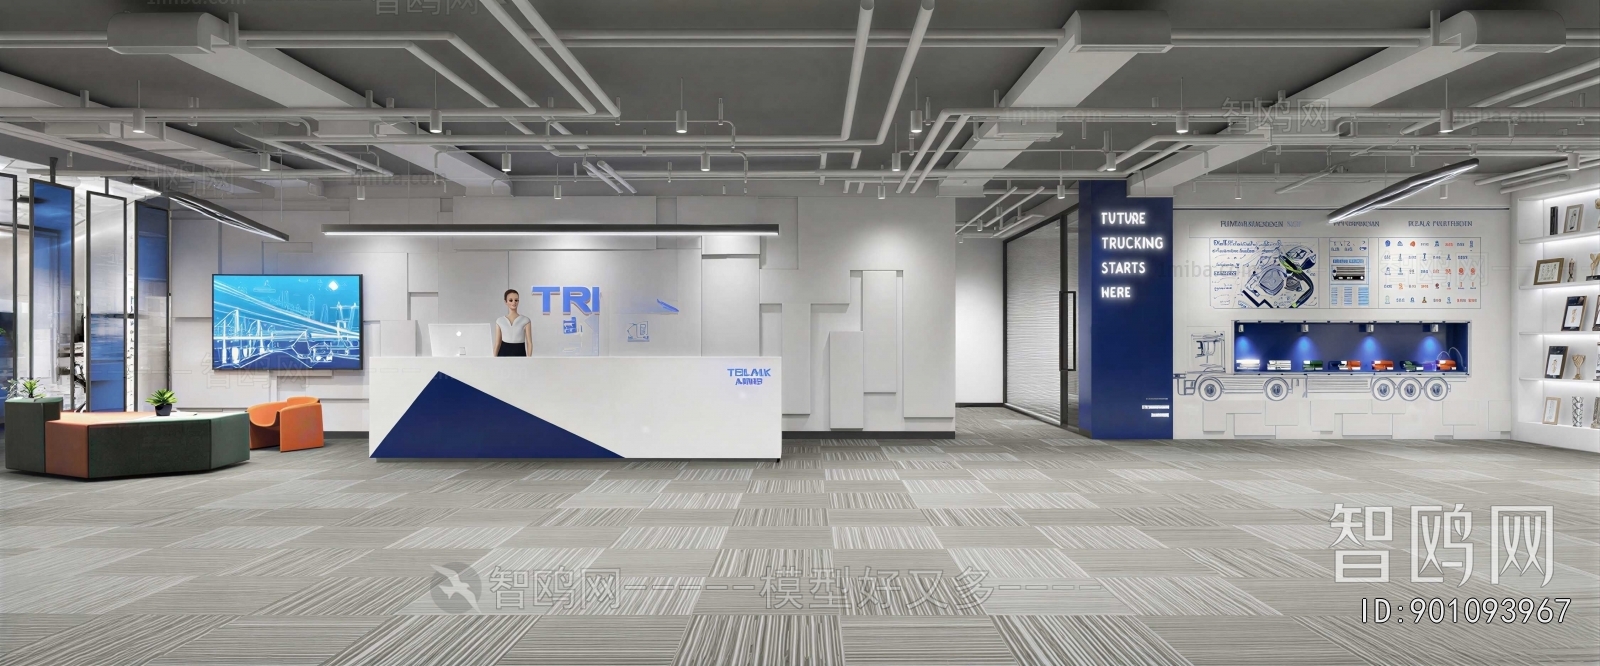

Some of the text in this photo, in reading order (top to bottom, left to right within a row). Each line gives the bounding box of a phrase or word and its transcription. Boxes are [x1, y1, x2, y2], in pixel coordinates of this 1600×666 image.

[1101, 236, 1164, 250] TRUCKING
[1101, 261, 1146, 274] STARTS
[532, 286, 600, 315] TRI
